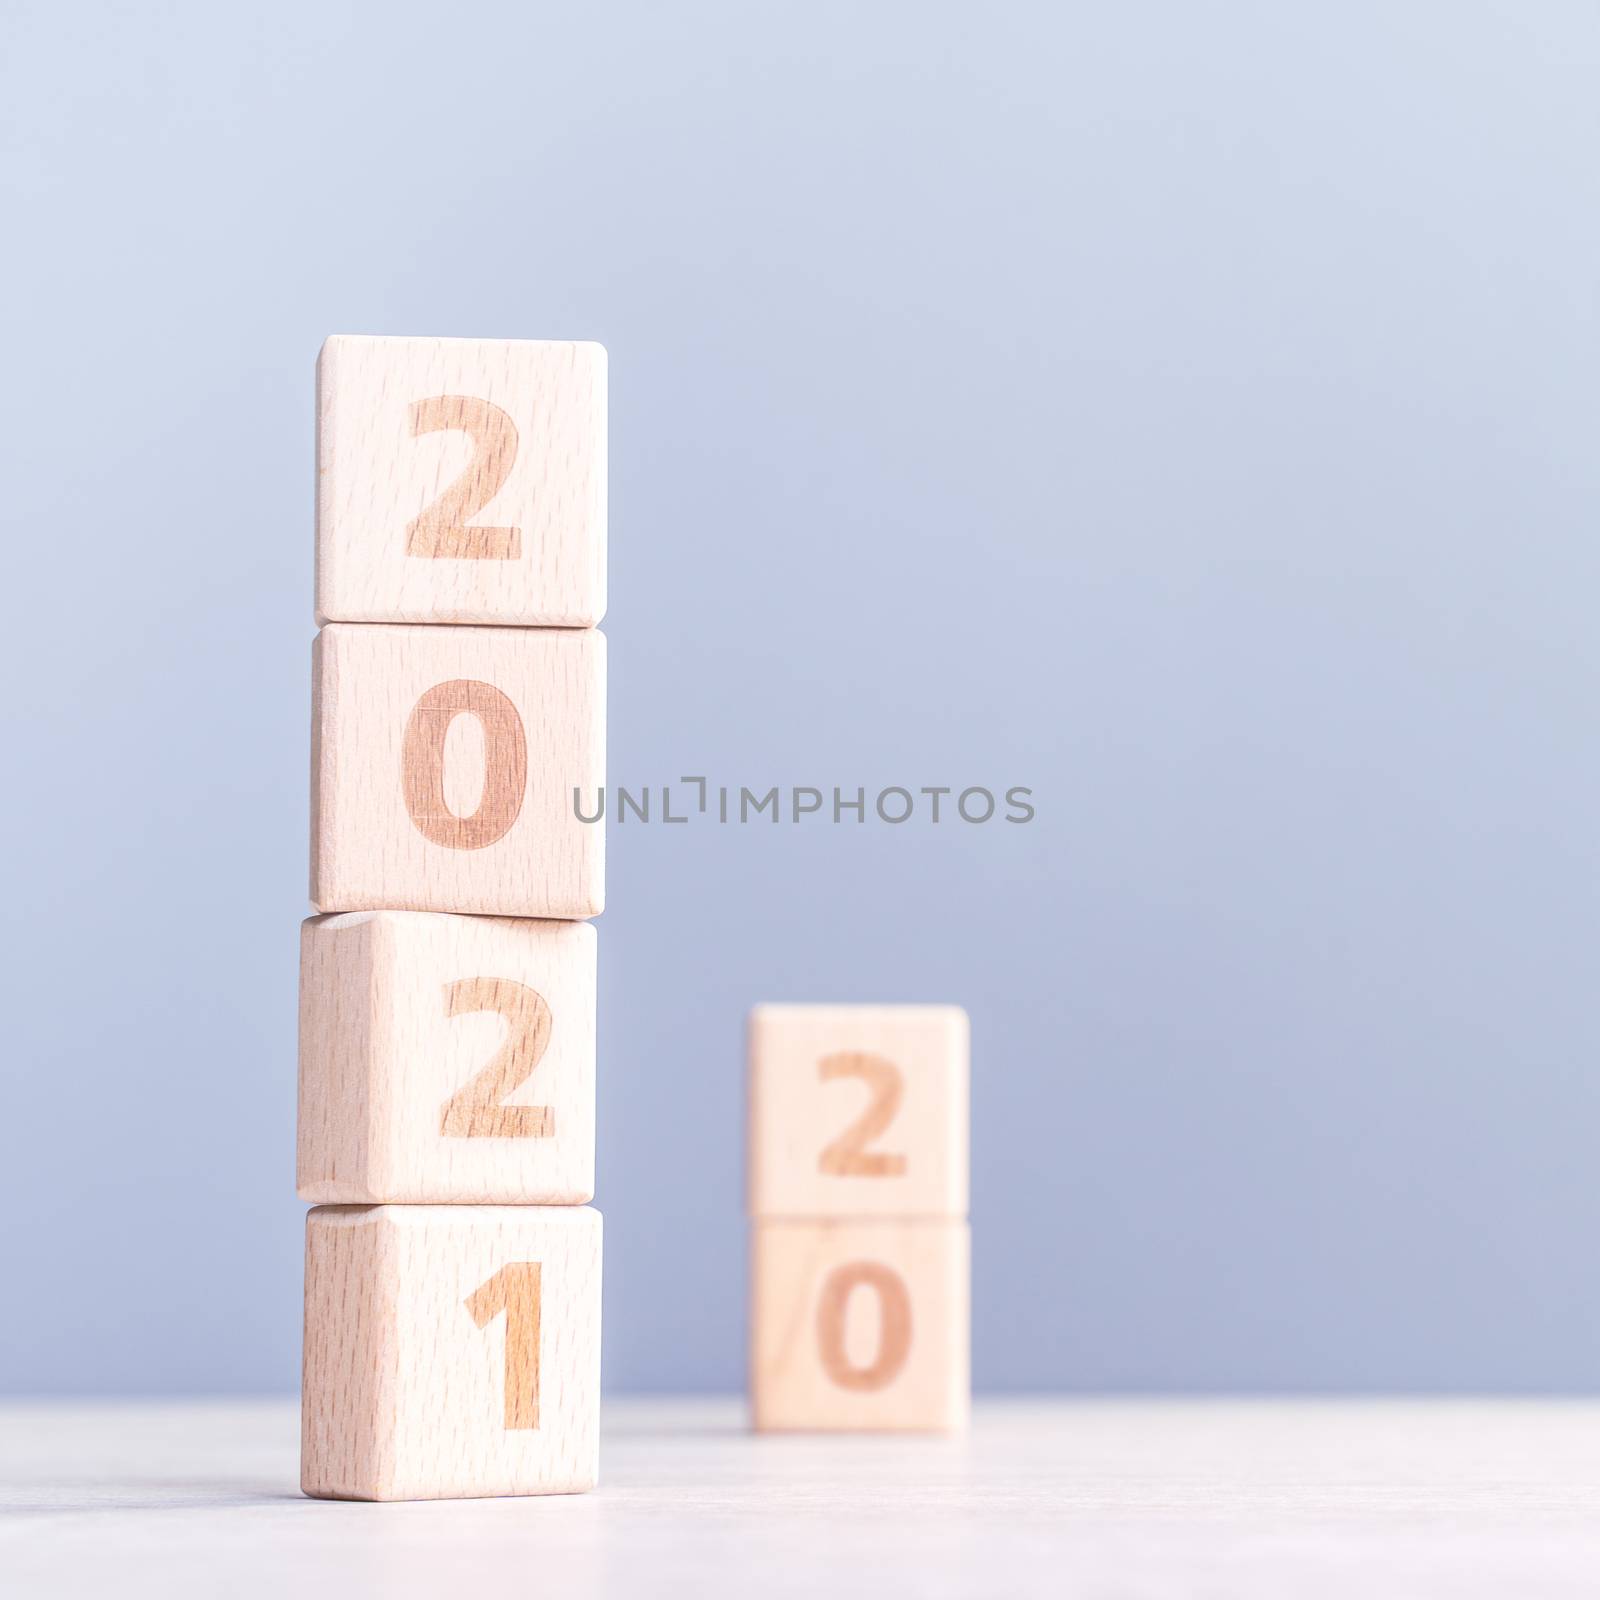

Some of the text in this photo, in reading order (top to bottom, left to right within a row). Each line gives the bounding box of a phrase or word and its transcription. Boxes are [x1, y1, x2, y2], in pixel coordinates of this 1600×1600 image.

[405, 394, 523, 561] 2
[401, 678, 528, 851] 0
[439, 976, 556, 1140] 2
[817, 1051, 908, 1179] 2
[464, 1261, 543, 1431] 1
[816, 1260, 913, 1393] 0
